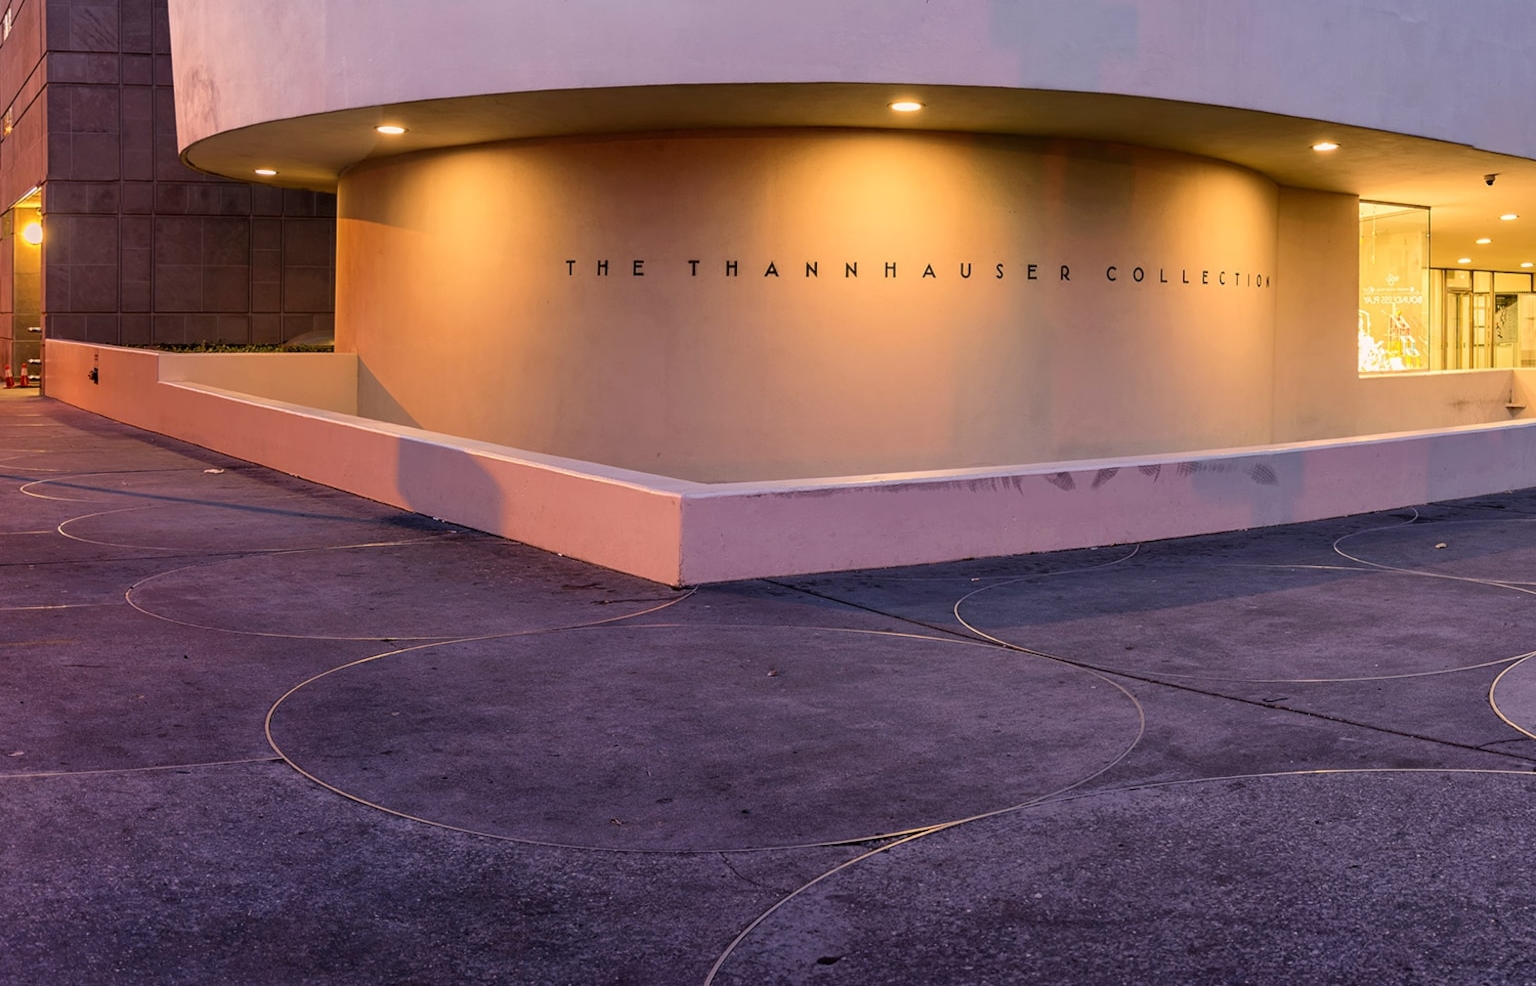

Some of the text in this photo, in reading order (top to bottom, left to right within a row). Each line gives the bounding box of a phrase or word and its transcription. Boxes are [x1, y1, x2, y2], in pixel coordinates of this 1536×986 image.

[565, 258, 1271, 289] THE THANNHAUSER COLLECTION
